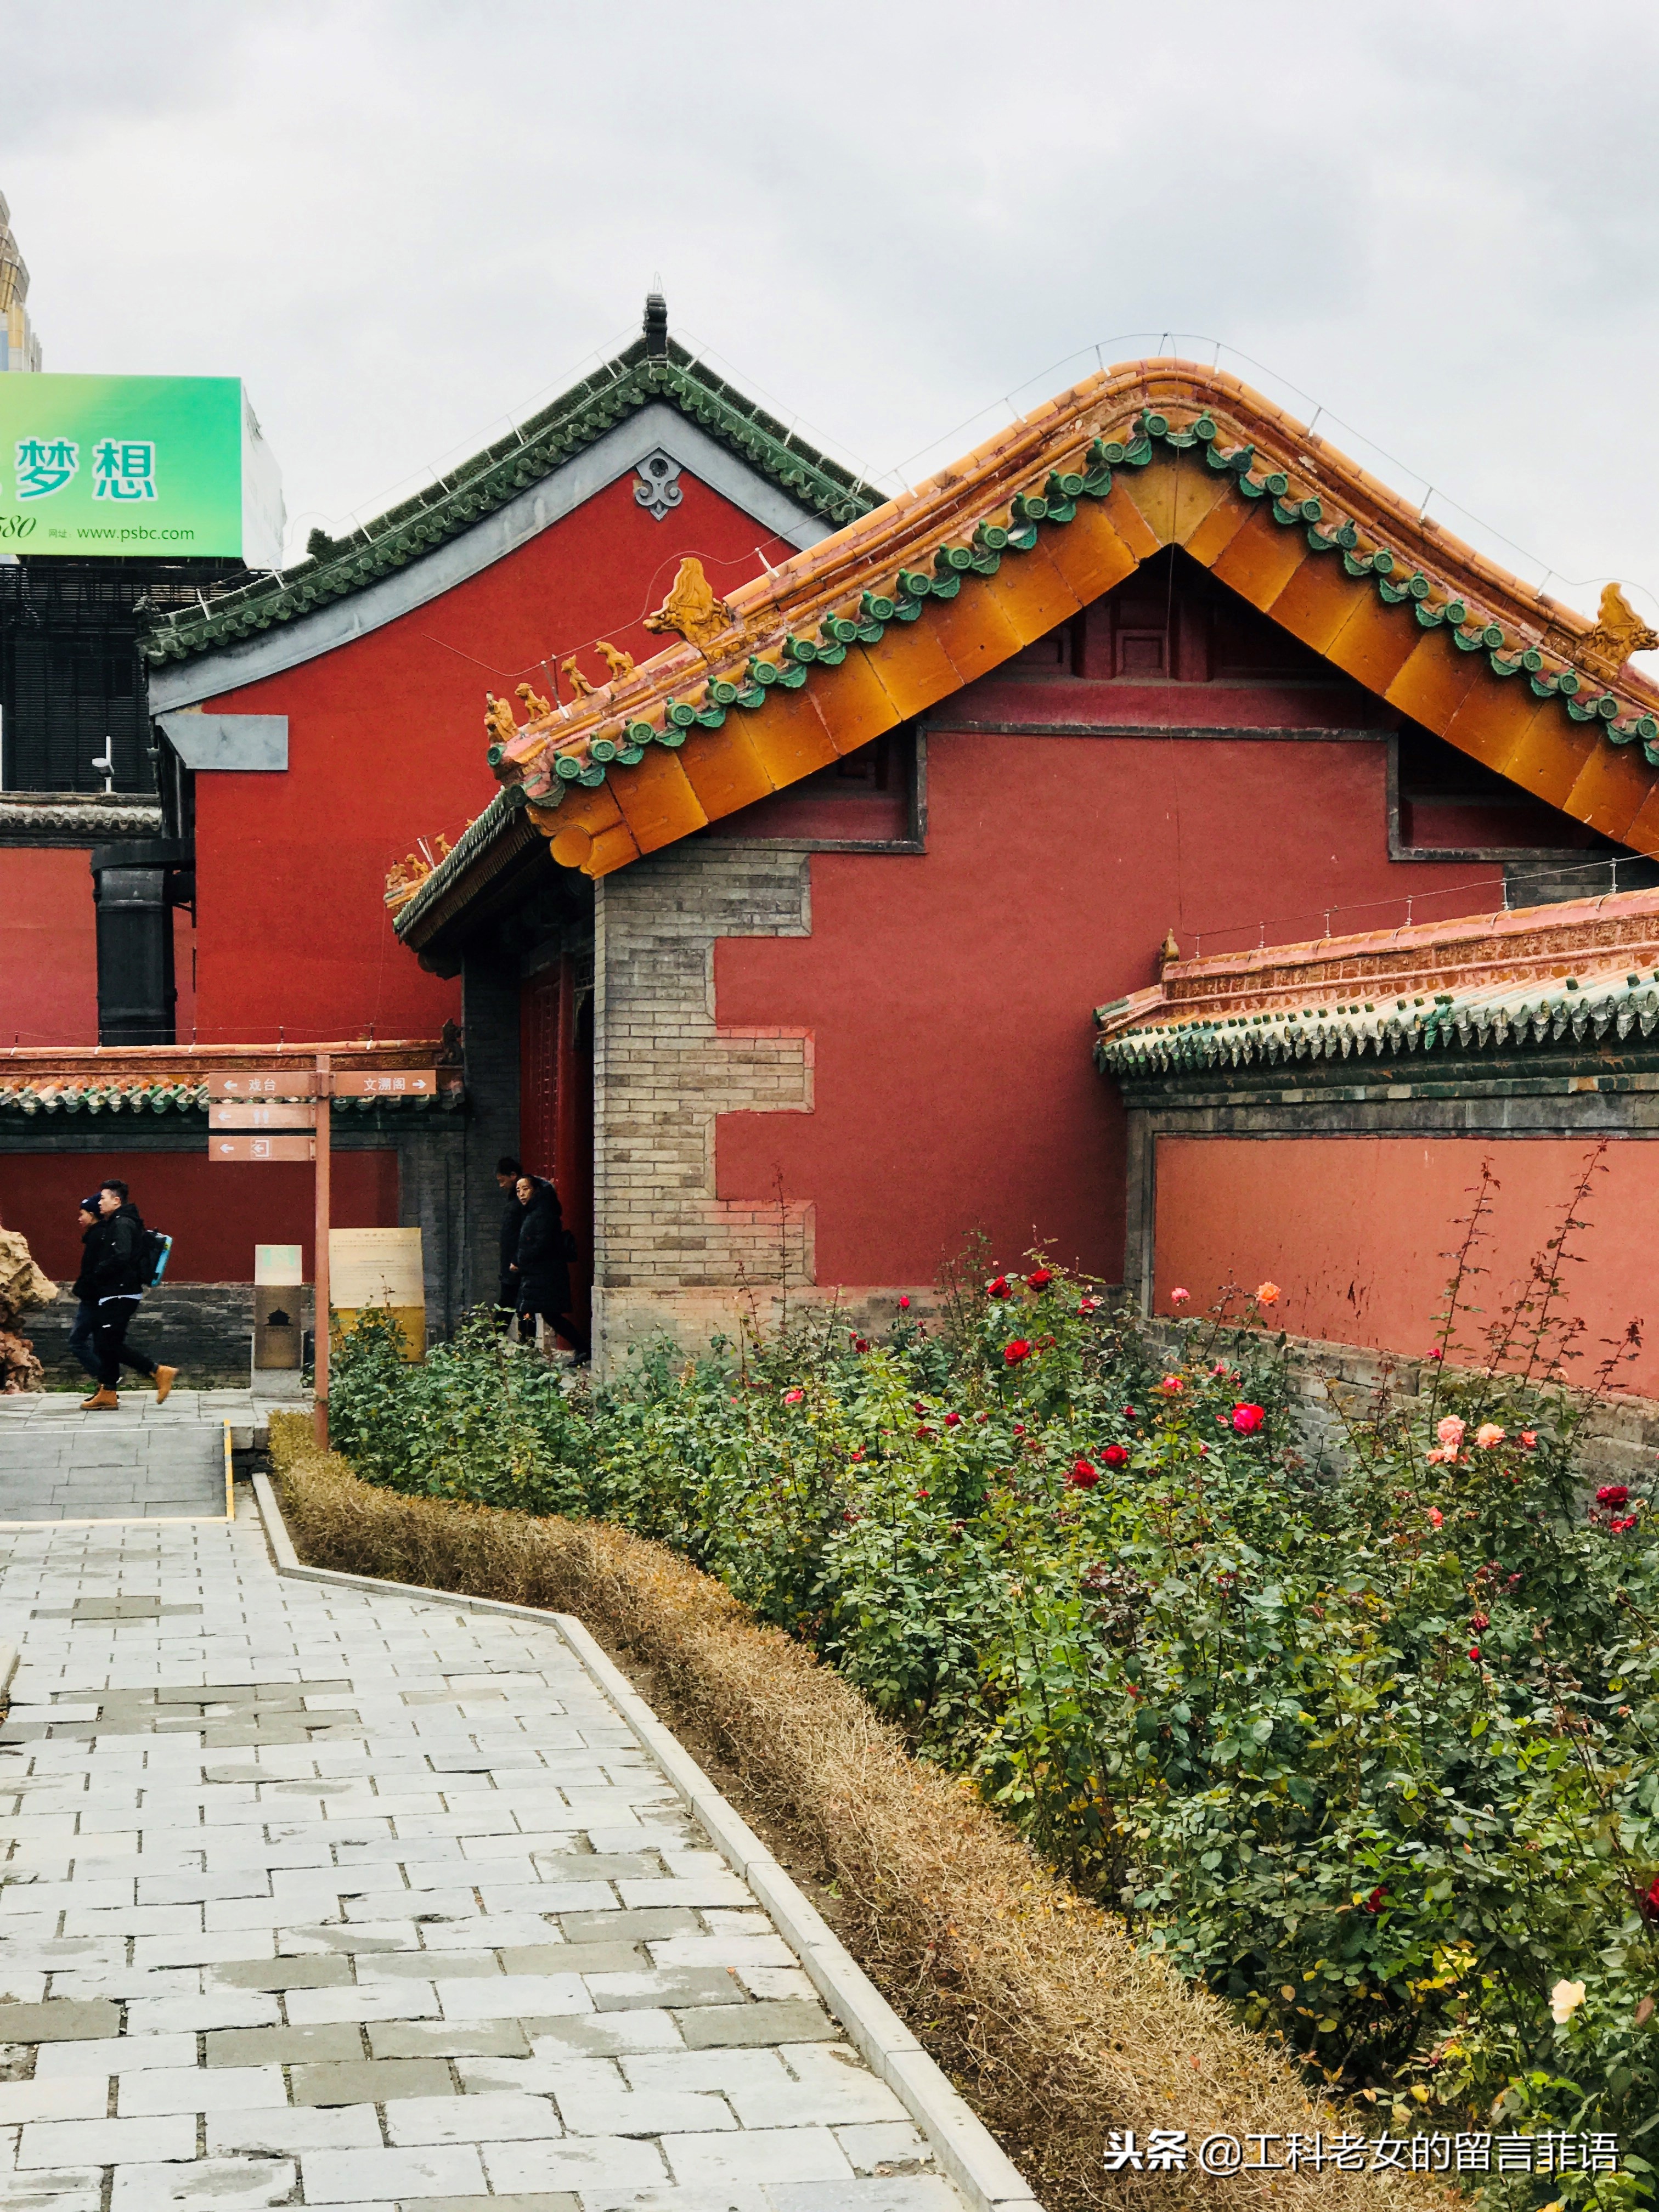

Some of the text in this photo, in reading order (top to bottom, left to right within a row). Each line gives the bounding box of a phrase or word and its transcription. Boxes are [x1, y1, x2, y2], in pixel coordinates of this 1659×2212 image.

[16, 438, 157, 500] 梦想
[0, 515, 37, 538] 80
[77, 526, 194, 541] www.psbc.com
[248, 1078, 276, 1092] 戏台
[364, 1077, 406, 1091] 文溯阁
